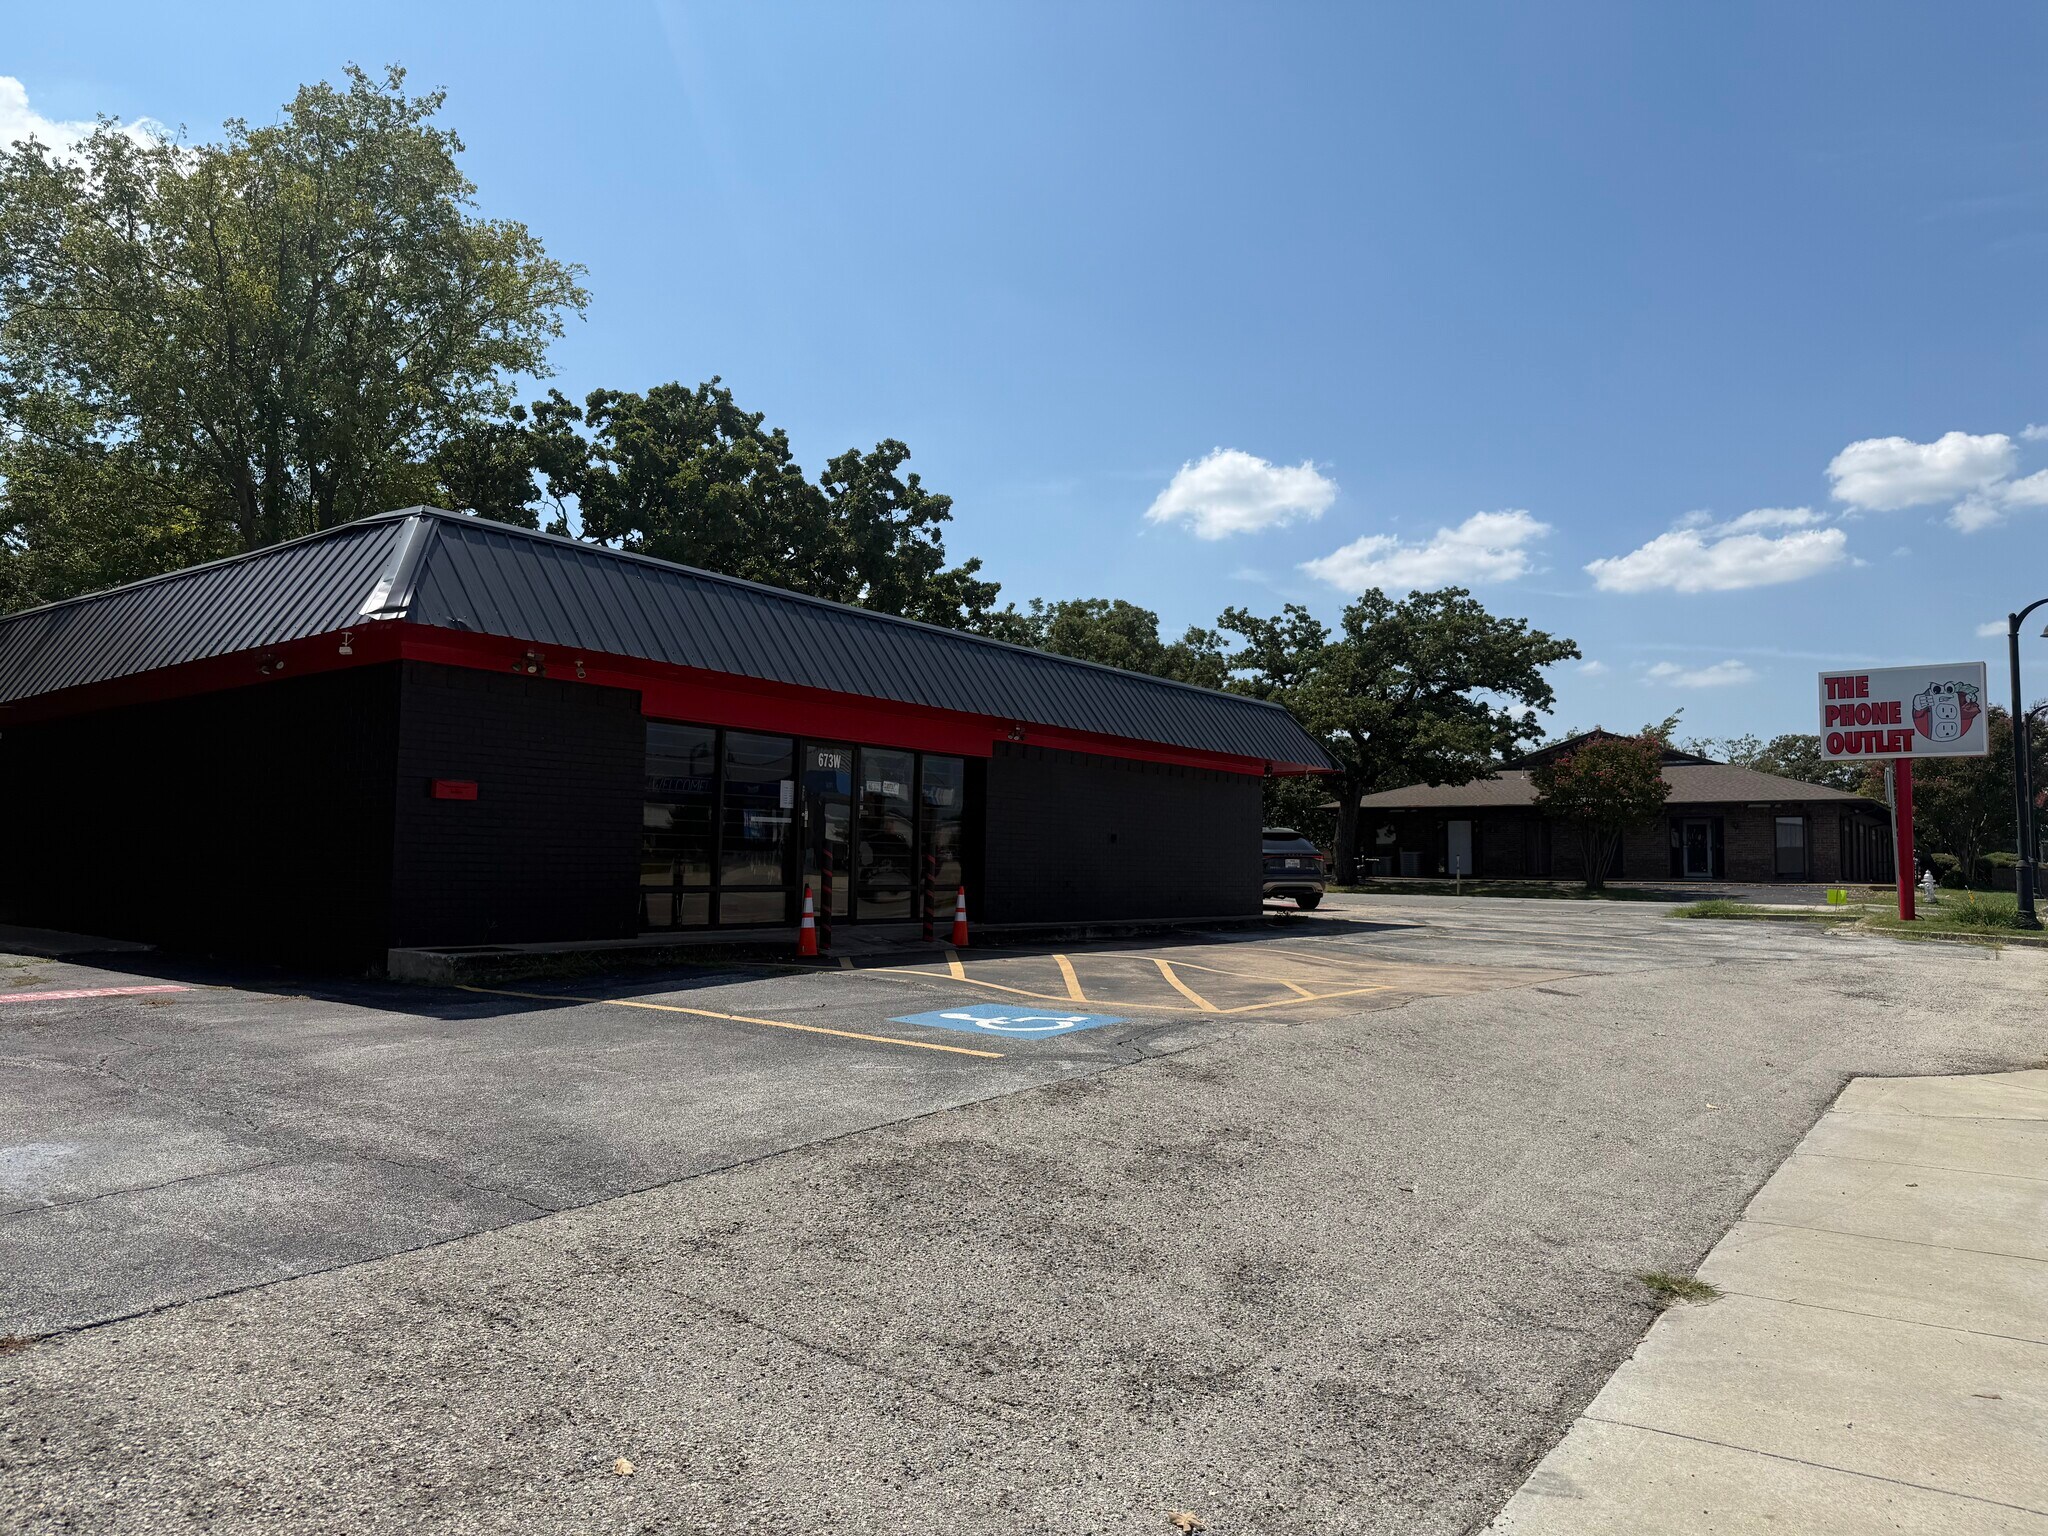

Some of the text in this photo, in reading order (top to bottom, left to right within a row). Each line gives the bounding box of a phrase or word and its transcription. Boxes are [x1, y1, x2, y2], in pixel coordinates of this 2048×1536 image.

[1824, 675, 1869, 700] THE
[1825, 701, 1902, 727] PHONE
[1826, 728, 1915, 755] OUTLET
[818, 752, 842, 769] 673W
